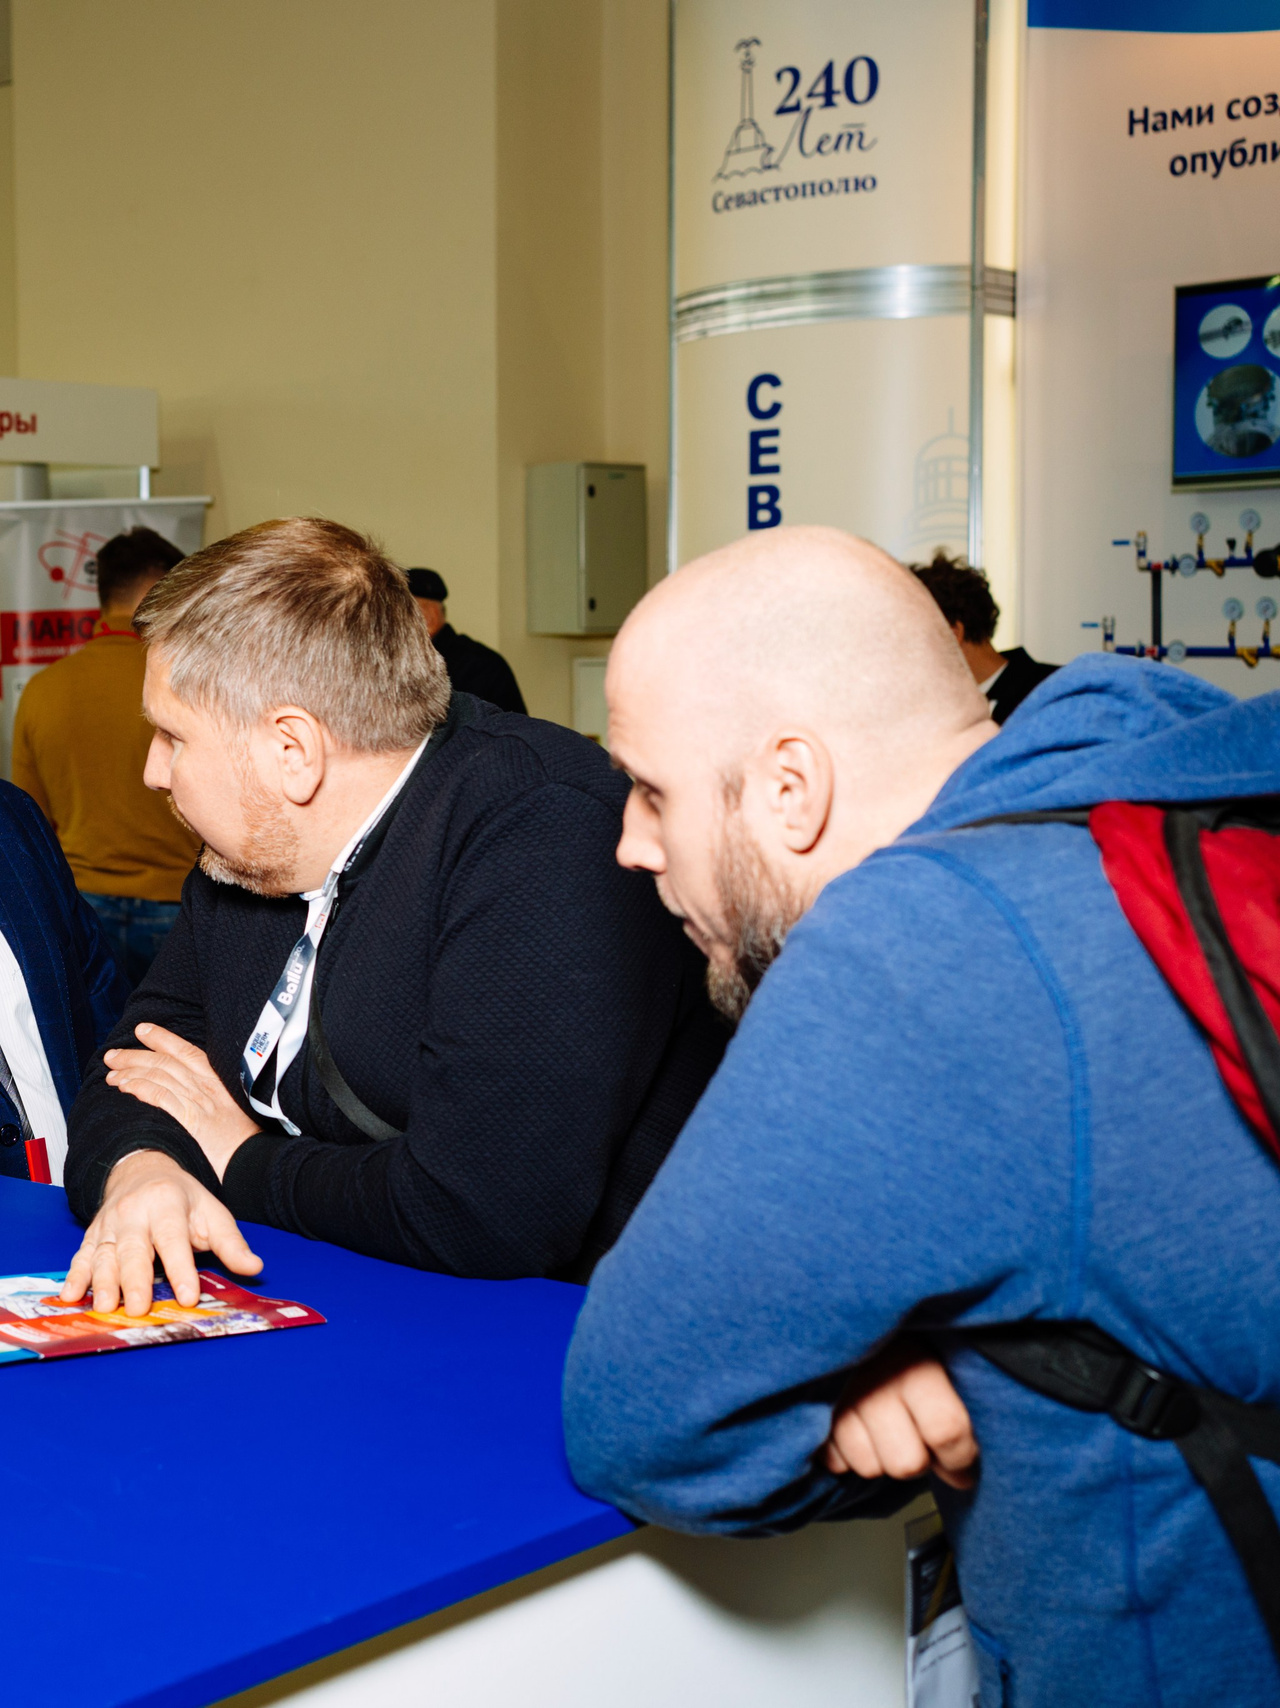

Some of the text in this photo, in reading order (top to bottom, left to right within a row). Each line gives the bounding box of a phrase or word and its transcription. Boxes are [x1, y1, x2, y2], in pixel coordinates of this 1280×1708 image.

[774, 55, 879, 116] 240
[1127, 92, 1280, 137] Нами соз
[712, 174, 877, 214] Севастополю
[746, 372, 783, 531] СЕВ
[13, 616, 97, 641] МАНО
[277, 962, 304, 1006] Ballu
